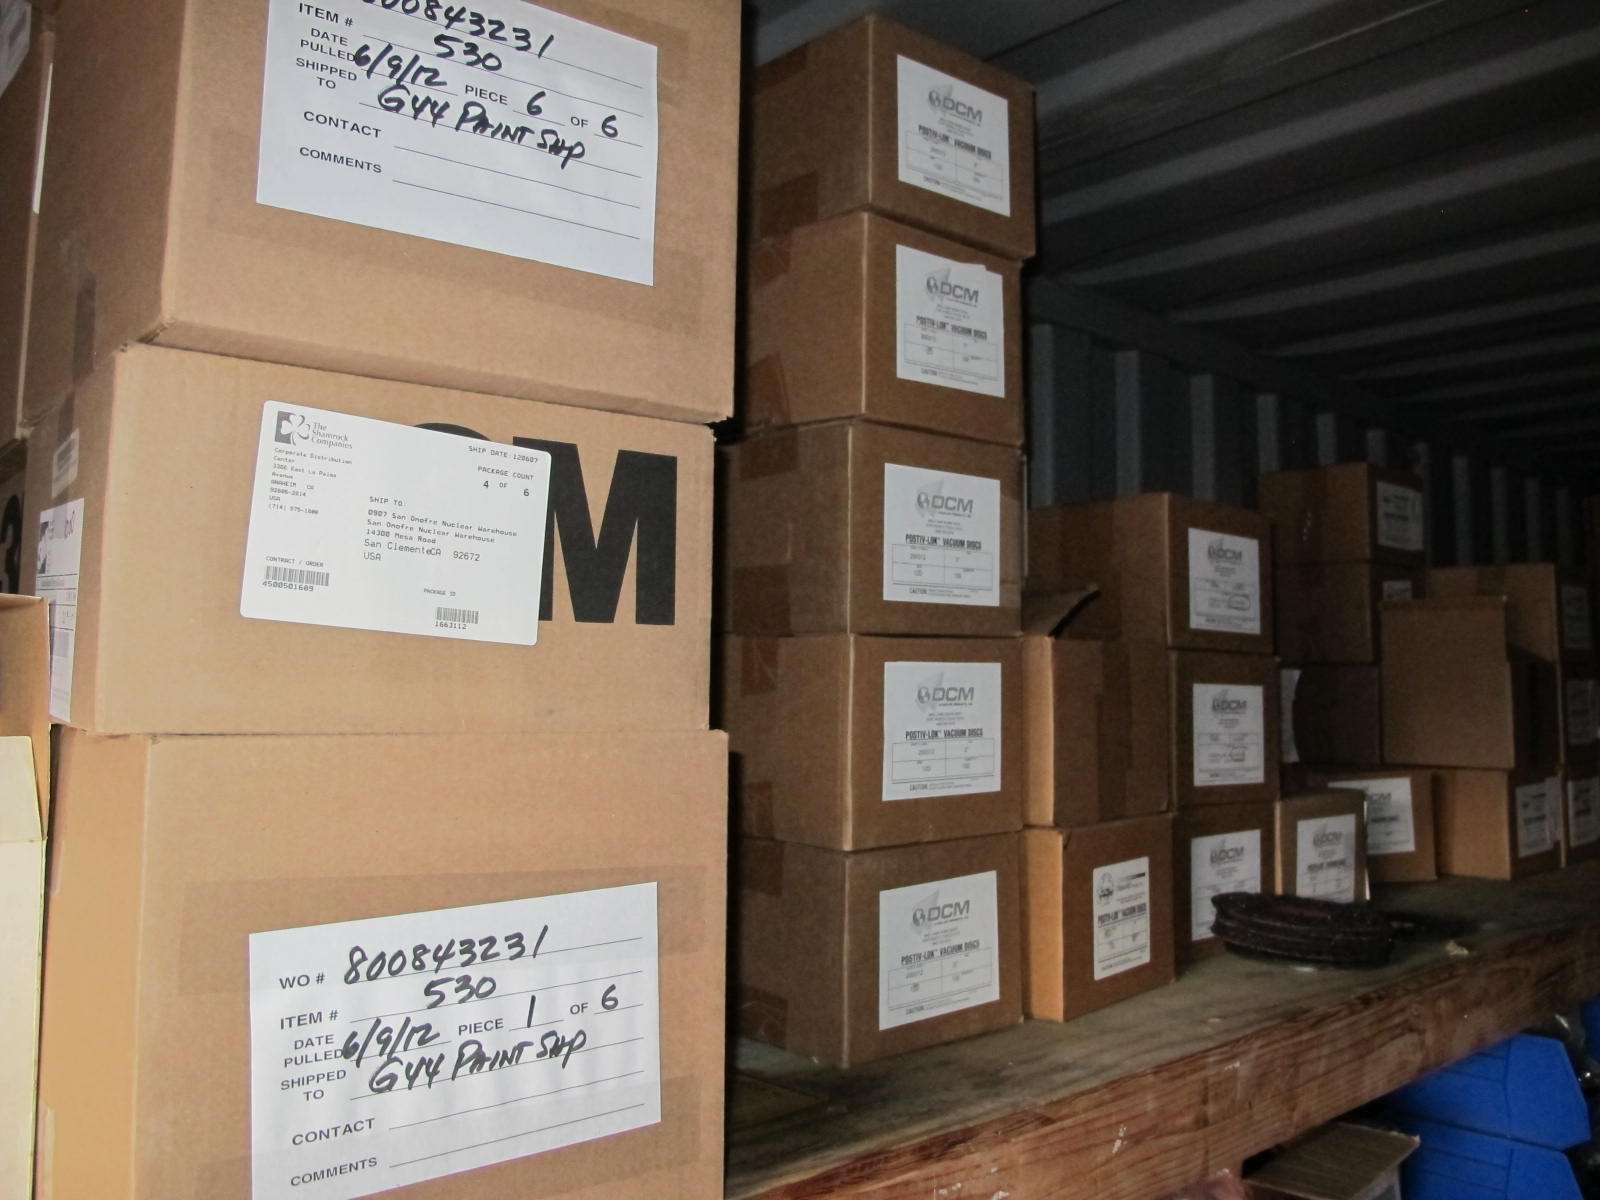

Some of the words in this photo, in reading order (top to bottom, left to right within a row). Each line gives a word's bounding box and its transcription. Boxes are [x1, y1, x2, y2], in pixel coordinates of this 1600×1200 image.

[299, 3, 339, 23] ITEM
[345, 17, 353, 27] #
[311, 28, 349, 46] DATE
[362, 0, 554, 58] 00843231
[300, 39, 356, 62] PULLED
[434, 34, 502, 71] 530
[296, 57, 357, 81] SHIPPED
[355, 43, 447, 85] 6/9/12
[316, 77, 336, 89] TO
[465, 84, 508, 105] PIECE
[527, 91, 546, 116] 6
[570, 116, 589, 128] OF
[601, 115, 618, 138] 6
[942, 97, 983, 123] DCM
[303, 111, 382, 139] CONTACT
[455, 101, 535, 144] PAINT
[300, 147, 382, 174] COMMENTS
[940, 282, 979, 303] DCM
[312, 430, 349, 441] Shamrock
[314, 422, 327, 430] The
[311, 437, 352, 449] Companies
[468, 445, 486, 454] SHIP
[490, 449, 508, 458] DATE
[478, 465, 508, 477] PACKAGE
[513, 472, 534, 481] COUNT
[483, 480, 489, 489] 4
[523, 488, 530, 497] 6
[369, 496, 388, 505] SHIP
[932, 495, 974, 513] DCM
[367, 519, 382, 527] San
[386, 522, 414, 531] Onofre
[419, 526, 449, 537] Nuclear
[455, 532, 495, 543] Warehouse
[392, 512, 406, 520] San
[411, 515, 437, 525] Onofre
[442, 519, 473, 530] Nuclear
[477, 526, 517, 537] Warehouse
[395, 533, 413, 541] Mesa
[418, 535, 436, 544] Road
[363, 552, 381, 561] USA
[364, 539, 381, 549] San
[453, 551, 480, 561] 92672
[932, 687, 974, 701] DCM
[927, 900, 970, 921] DCM
[344, 925, 549, 984] 800843231
[279, 974, 310, 989] WO
[316, 973, 325, 984] #
[424, 974, 497, 1010] 530
[280, 1011, 322, 1030] ITEM
[329, 1009, 338, 1021] #
[458, 1018, 504, 1035] PIECE
[527, 994, 536, 1028] 1
[570, 1002, 589, 1015] OF
[601, 984, 618, 1010] 6
[294, 1034, 335, 1050] DATE
[342, 1016, 440, 1068] 6/9/12
[284, 1048, 344, 1068] PULLED
[451, 1039, 534, 1081] PAINT
[280, 1069, 347, 1090] SHIPPED
[303, 1088, 325, 1101] TO
[292, 1117, 375, 1146] CONTACT
[290, 1157, 377, 1187] COMMENTS
